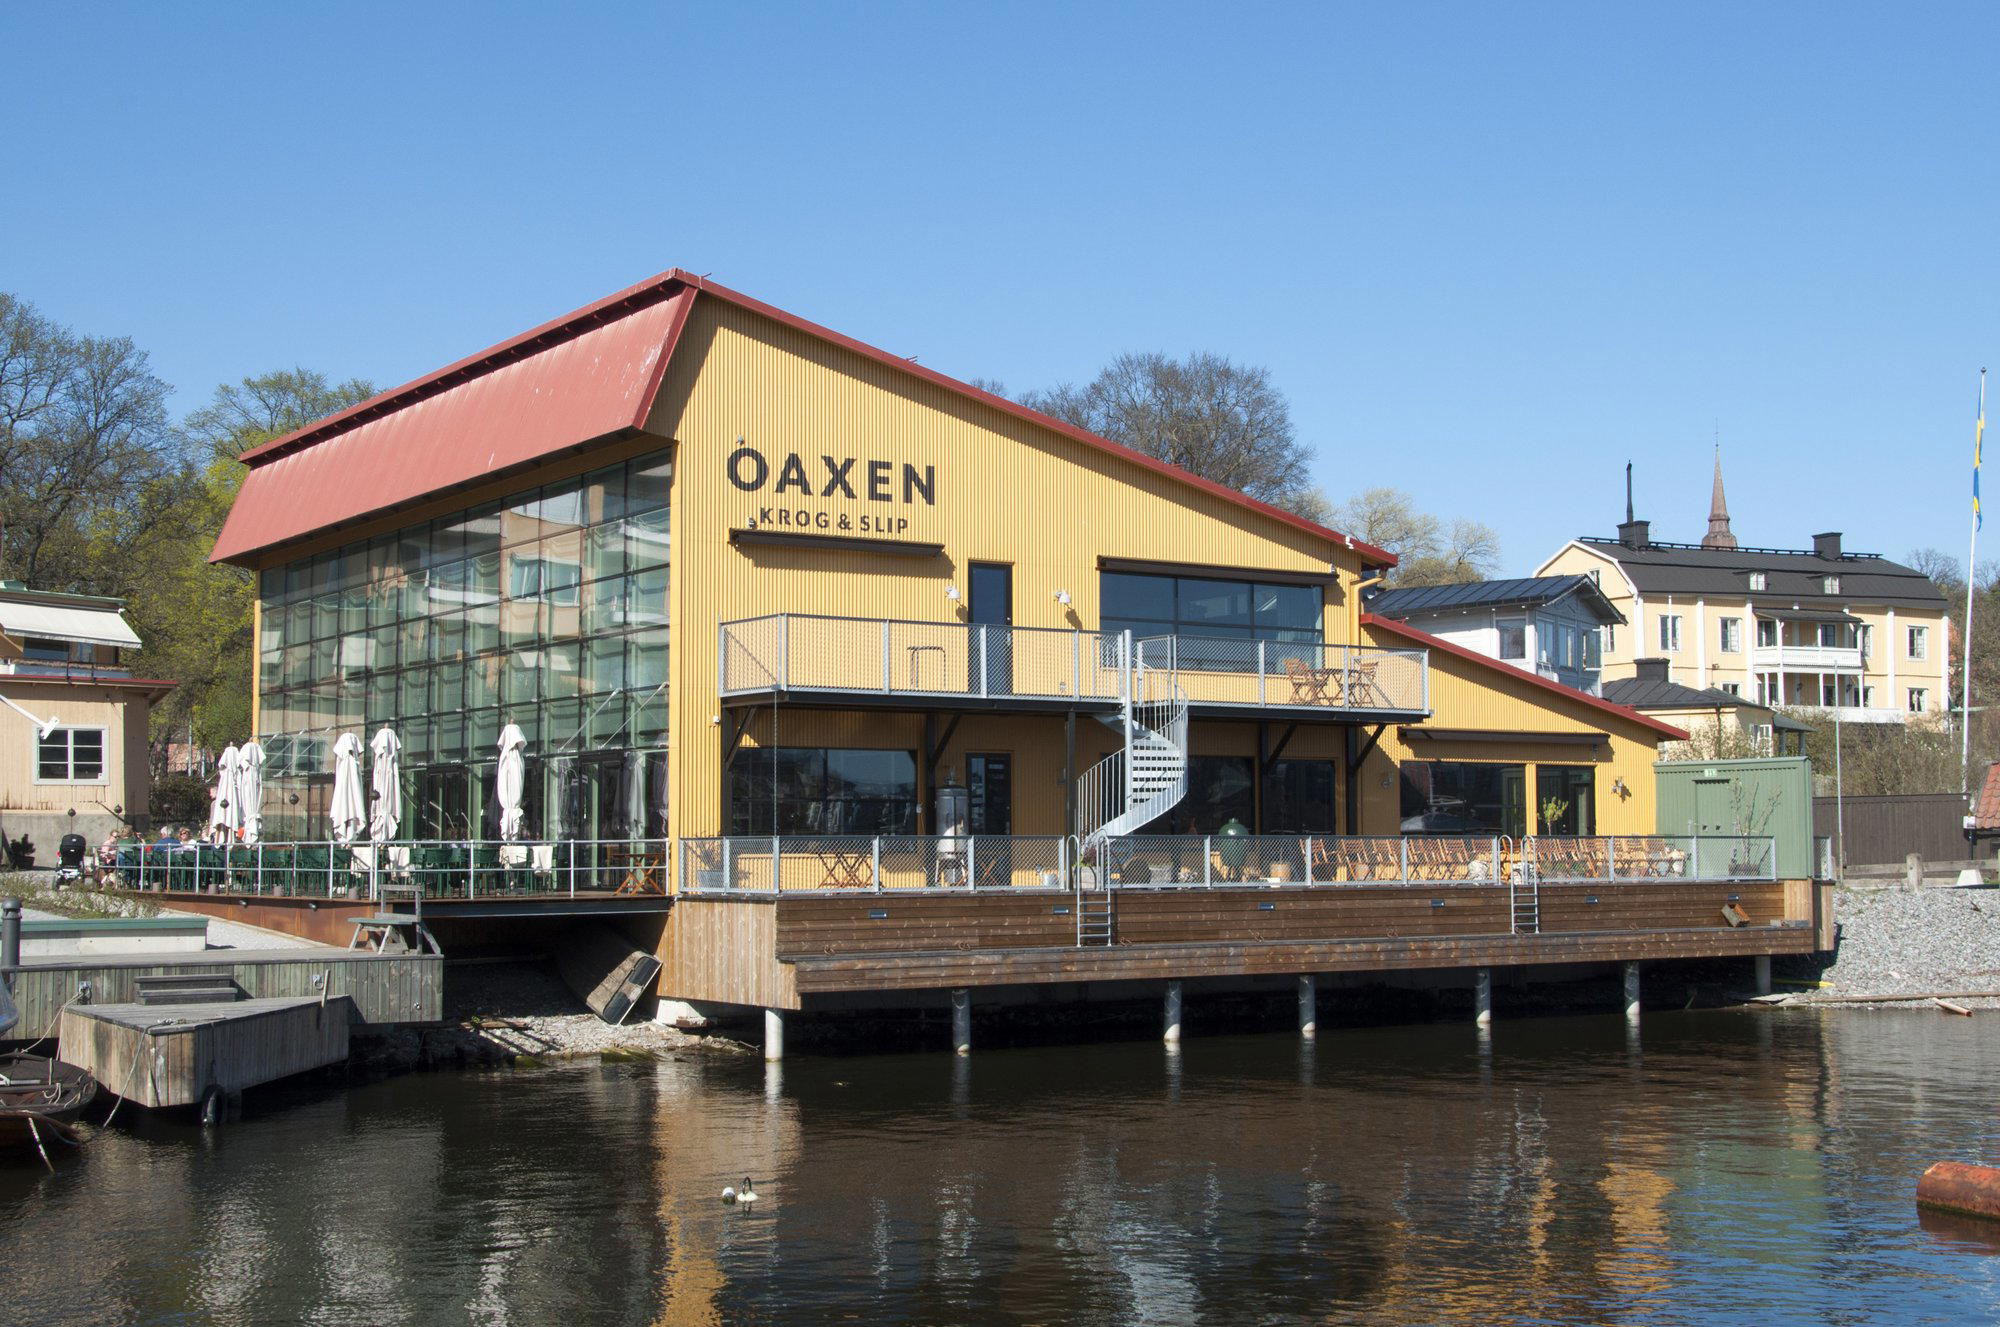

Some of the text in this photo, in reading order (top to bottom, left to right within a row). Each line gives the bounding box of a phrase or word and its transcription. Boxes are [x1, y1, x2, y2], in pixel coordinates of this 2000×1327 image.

[727, 447, 936, 506] OAXEN
[759, 507, 830, 529] KROG
[860, 515, 908, 534] SLIP
